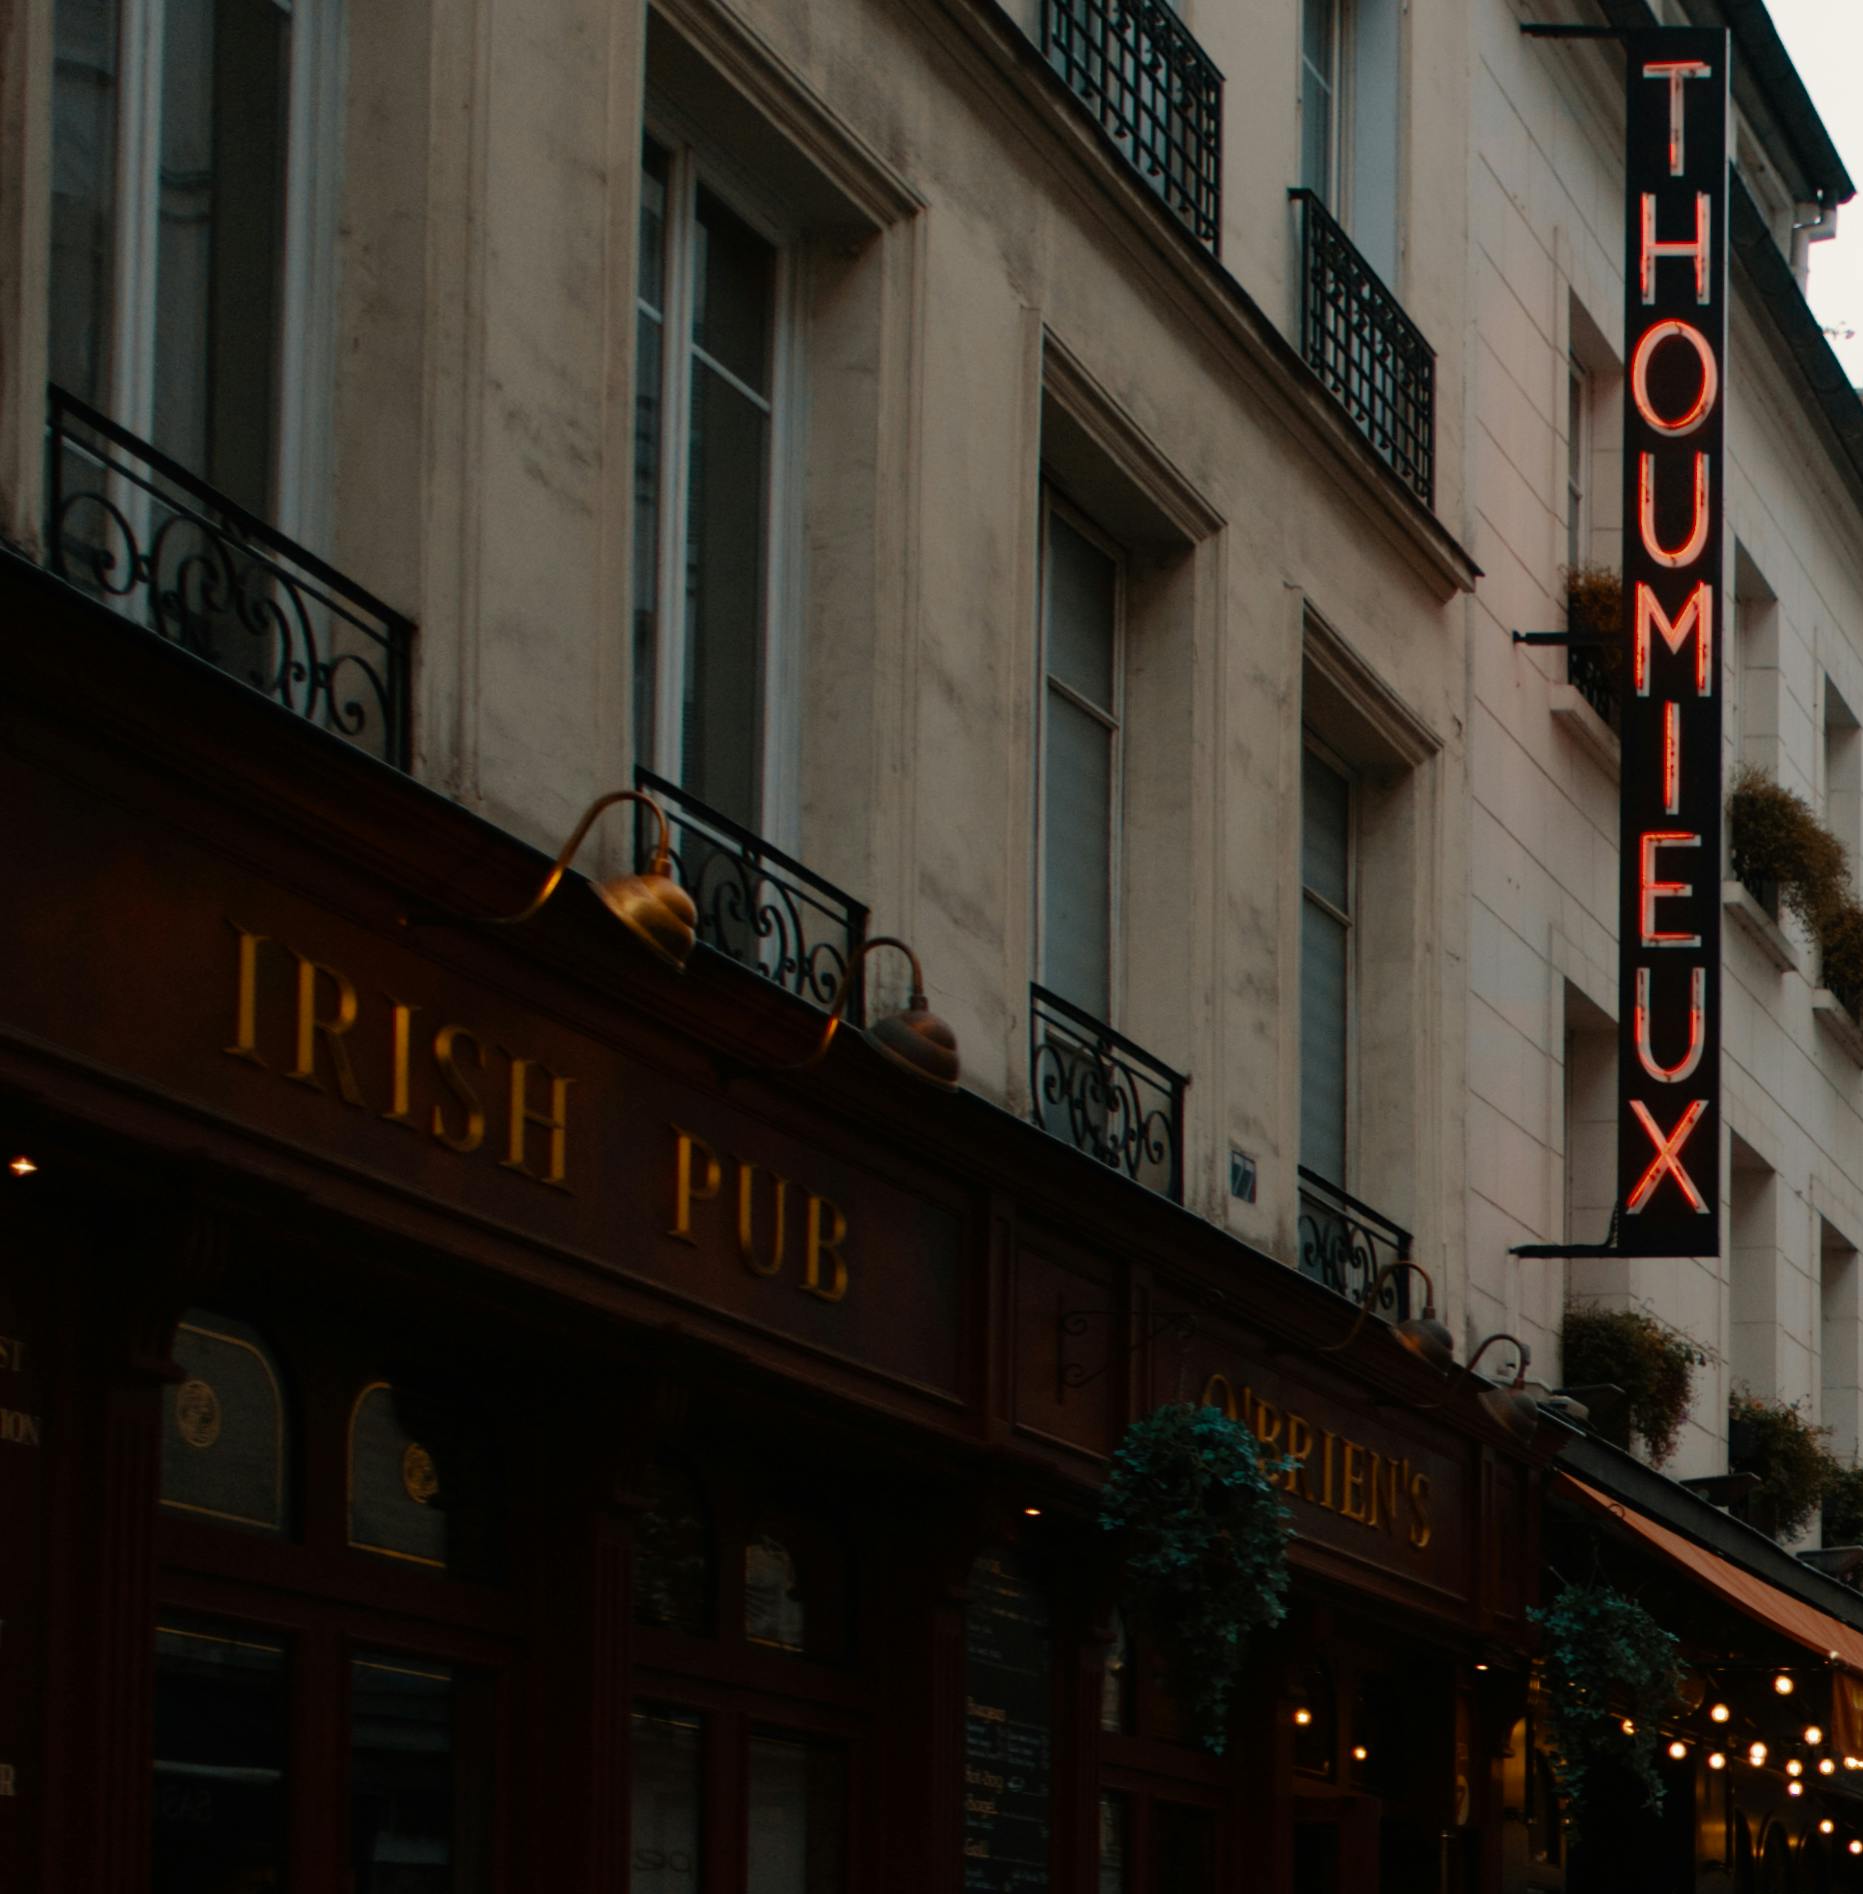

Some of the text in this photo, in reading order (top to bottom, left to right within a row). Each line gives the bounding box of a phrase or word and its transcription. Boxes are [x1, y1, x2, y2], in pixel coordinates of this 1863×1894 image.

[1626, 60, 1719, 1215] THOUMIEUX
[222, 919, 851, 1305] IRISH PUB
